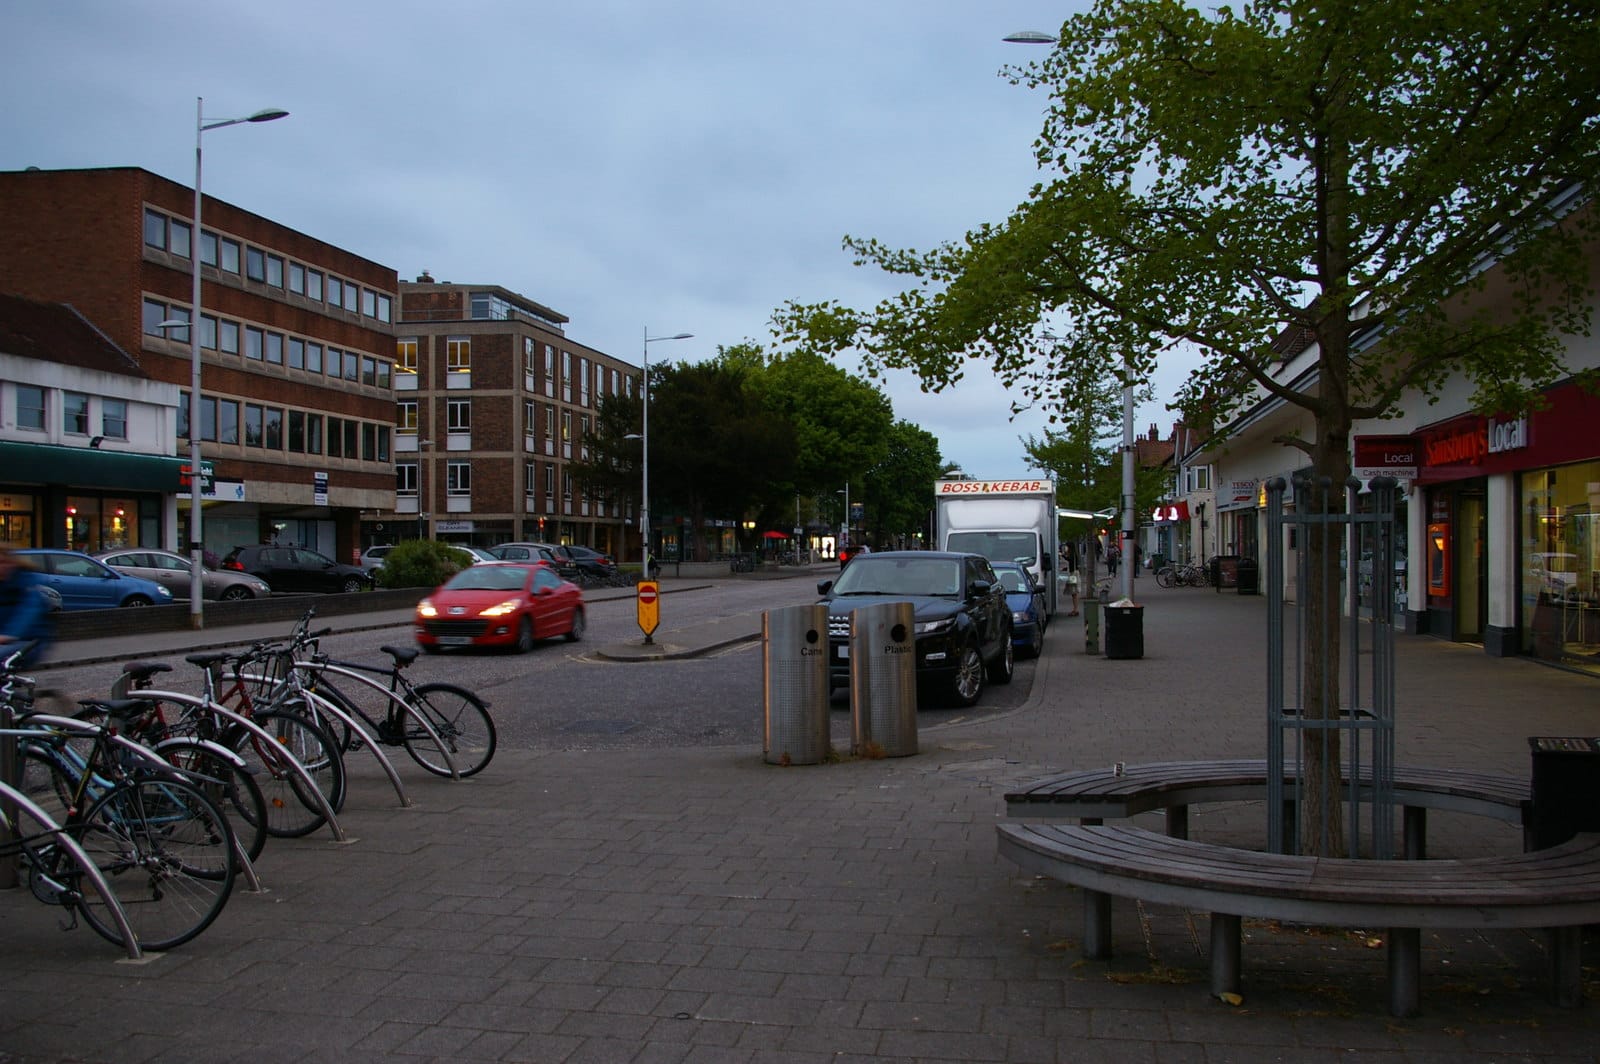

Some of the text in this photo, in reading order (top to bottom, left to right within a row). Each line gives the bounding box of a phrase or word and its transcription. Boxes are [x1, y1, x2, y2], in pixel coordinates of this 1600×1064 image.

[1488, 411, 1528, 453] Local
[1384, 452, 1413, 464] Local
[942, 483, 980, 493] BOSS
[991, 481, 1041, 492] KEBAB
[801, 647, 823, 656] Cans
[884, 645, 912, 654] Plastic
